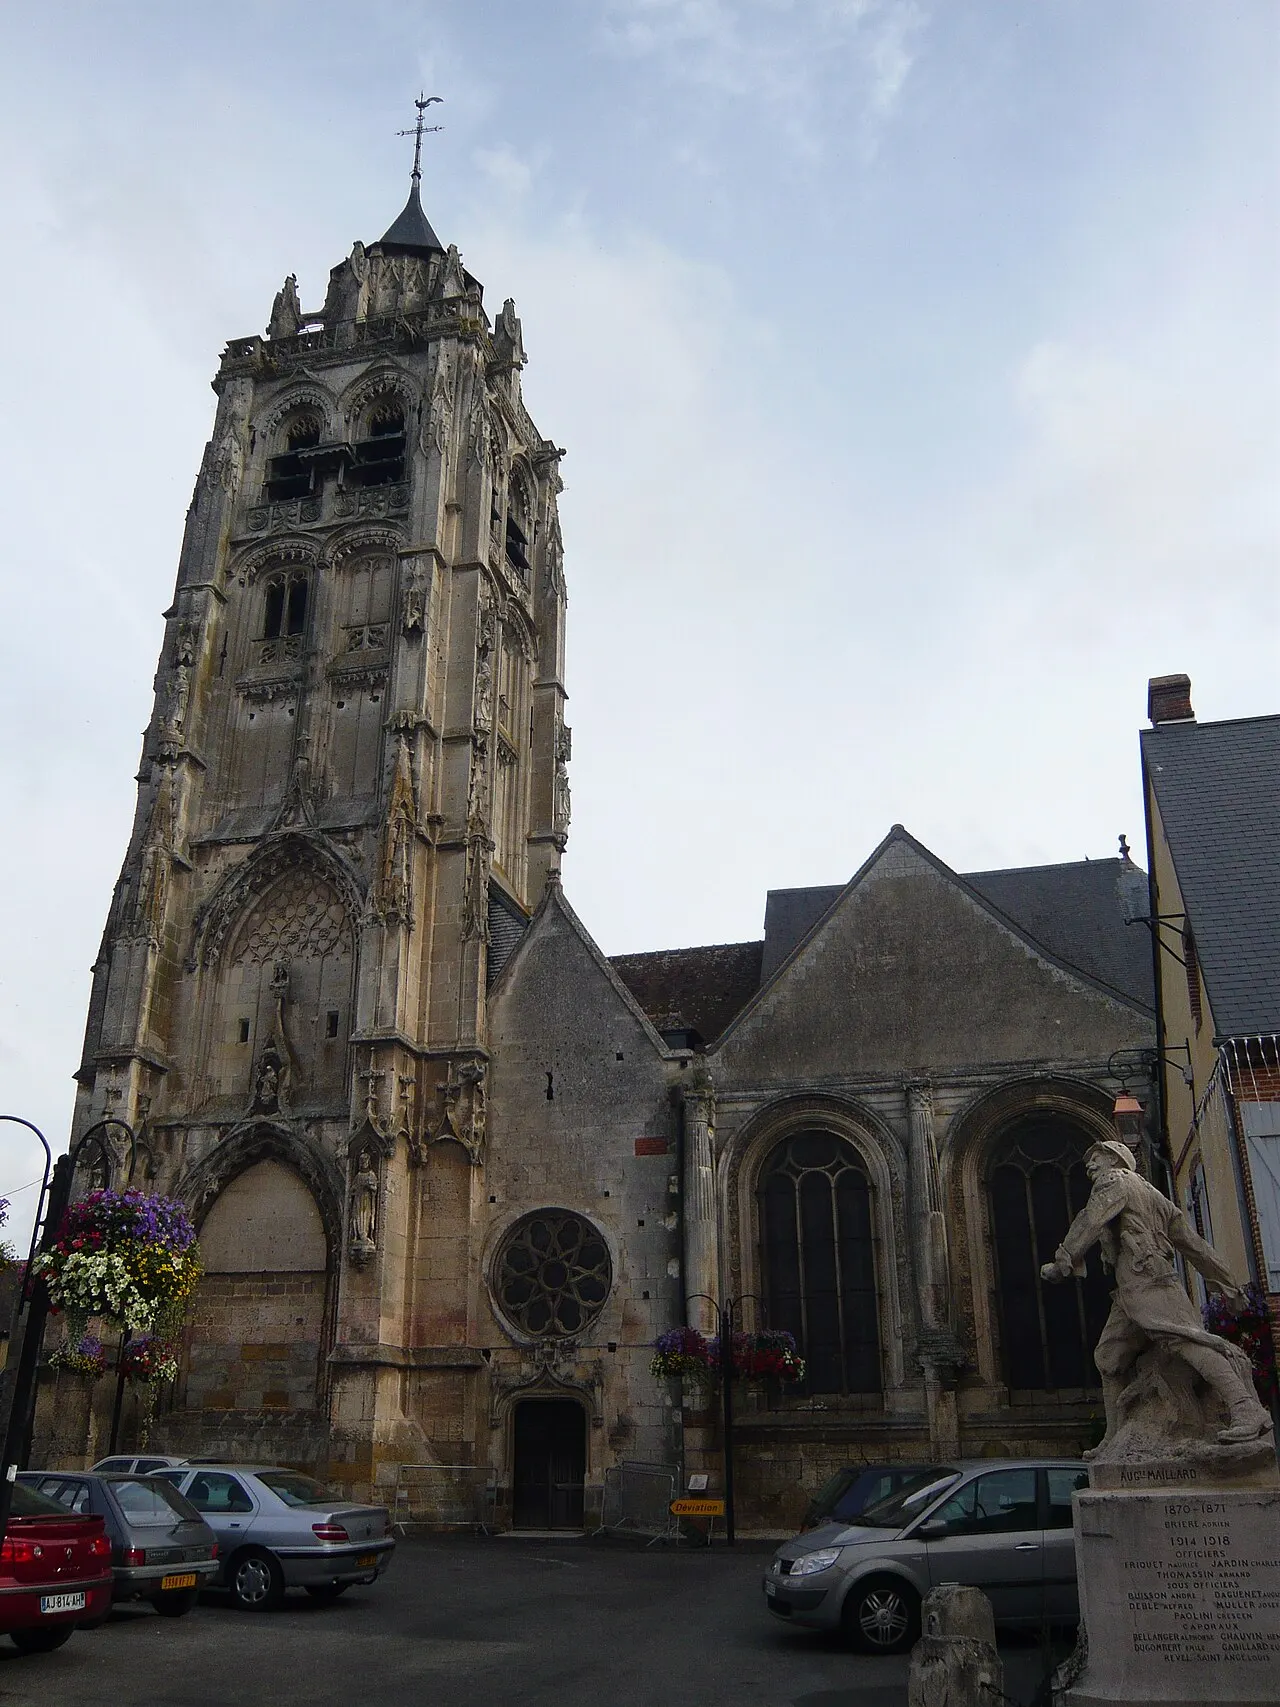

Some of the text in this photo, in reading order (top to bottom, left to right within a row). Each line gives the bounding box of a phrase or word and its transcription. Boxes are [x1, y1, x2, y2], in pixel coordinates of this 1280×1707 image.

[1147, 1468, 1197, 1480] MAILLARD
[675, 1503, 718, 1512] Déviation
[1164, 1520, 1200, 1529] BRIERE
[1170, 1535, 1231, 1546] 1914 1918
[1175, 1550, 1226, 1558] OFFICIERS
[1167, 1561, 1199, 1569] MAURICE
[1211, 1559, 1249, 1568] JARDIN
[1156, 1571, 1215, 1579] THOMASSIN
[1167, 1581, 1240, 1590] SOUS OFFICIERS
[1128, 1592, 1167, 1600] BUISSON
[1214, 1590, 1262, 1599] DAGUENET
[1216, 1600, 1256, 1609] MULLER
[1174, 1612, 1213, 1620] PAOLINI
[1182, 1623, 1239, 1631] CAPORAUX
[1133, 1633, 1180, 1642] BELLANGER
[1220, 1632, 1263, 1641] CHAUVIN
